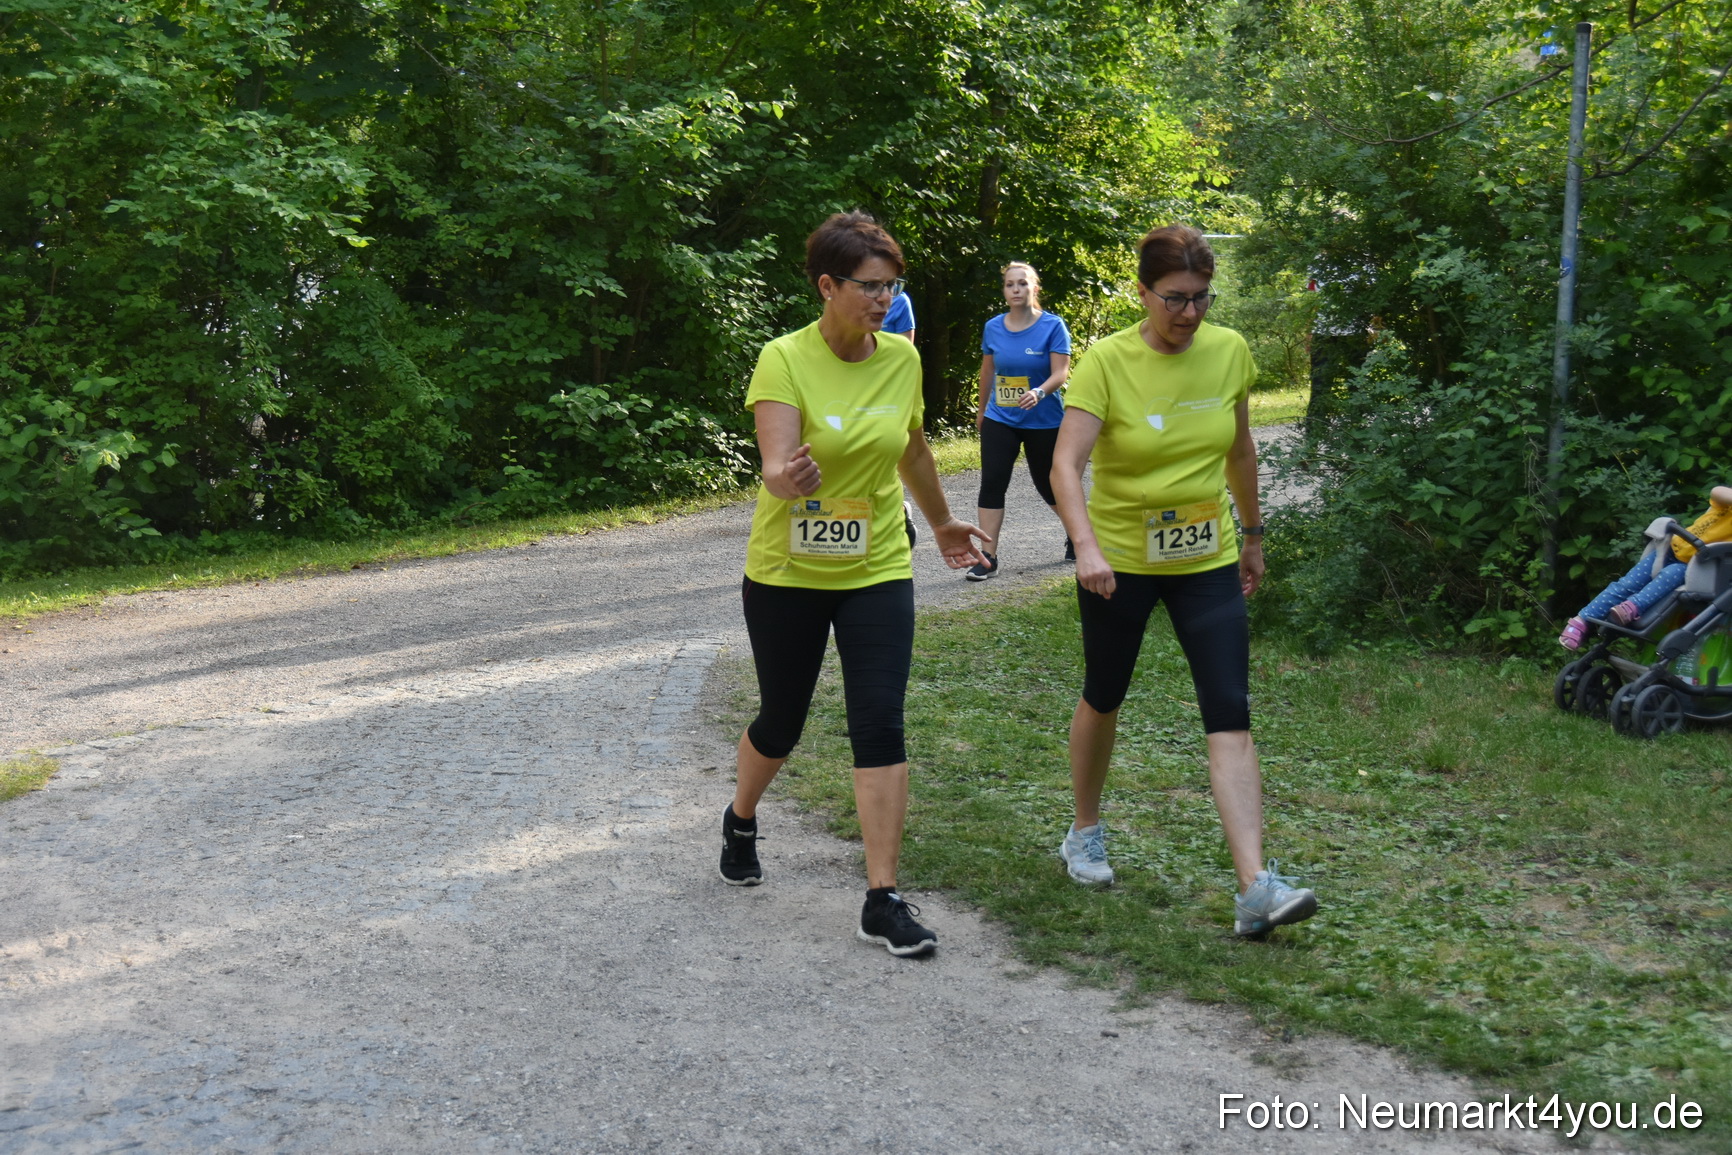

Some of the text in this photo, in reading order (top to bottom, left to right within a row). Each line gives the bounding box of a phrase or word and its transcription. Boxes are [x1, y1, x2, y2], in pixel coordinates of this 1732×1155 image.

[999, 388, 1025, 399] 1079
[798, 520, 860, 542] 1290
[1154, 521, 1212, 549] 1234
[1188, 544, 1208, 552] Renate
